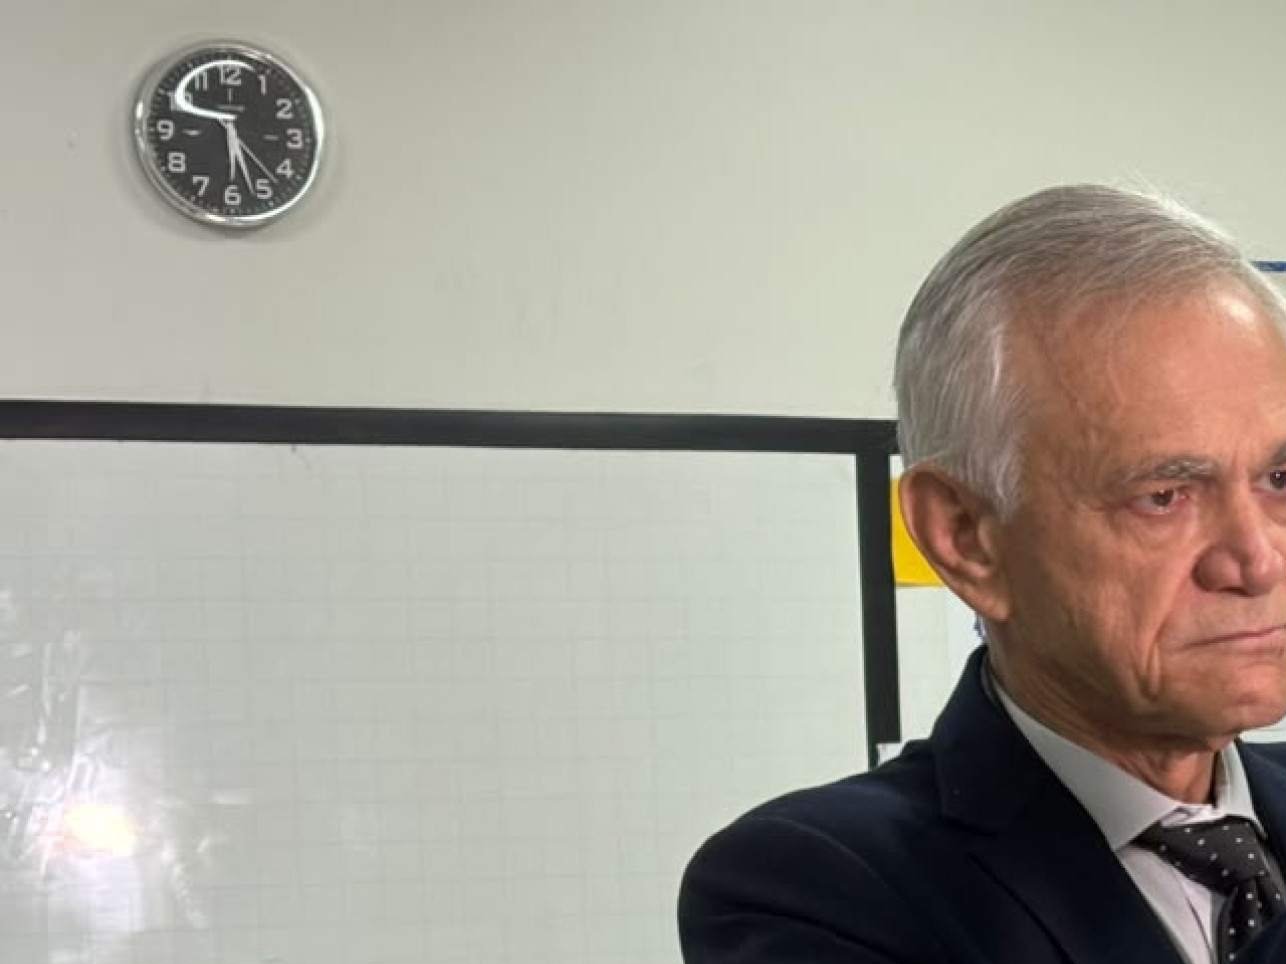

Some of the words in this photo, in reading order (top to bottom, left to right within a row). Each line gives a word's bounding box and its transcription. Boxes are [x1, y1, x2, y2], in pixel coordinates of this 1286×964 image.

[194, 70, 208, 91] 11
[220, 62, 242, 86] 12
[258, 75, 267, 96] 1
[276, 98, 293, 120] 2
[156, 120, 174, 141] 9
[286, 128, 303, 150] 3
[167, 152, 186, 173] 8
[276, 158, 294, 178] 4
[192, 175, 210, 196] 7
[224, 185, 241, 206] 6
[255, 179, 273, 199] 5
